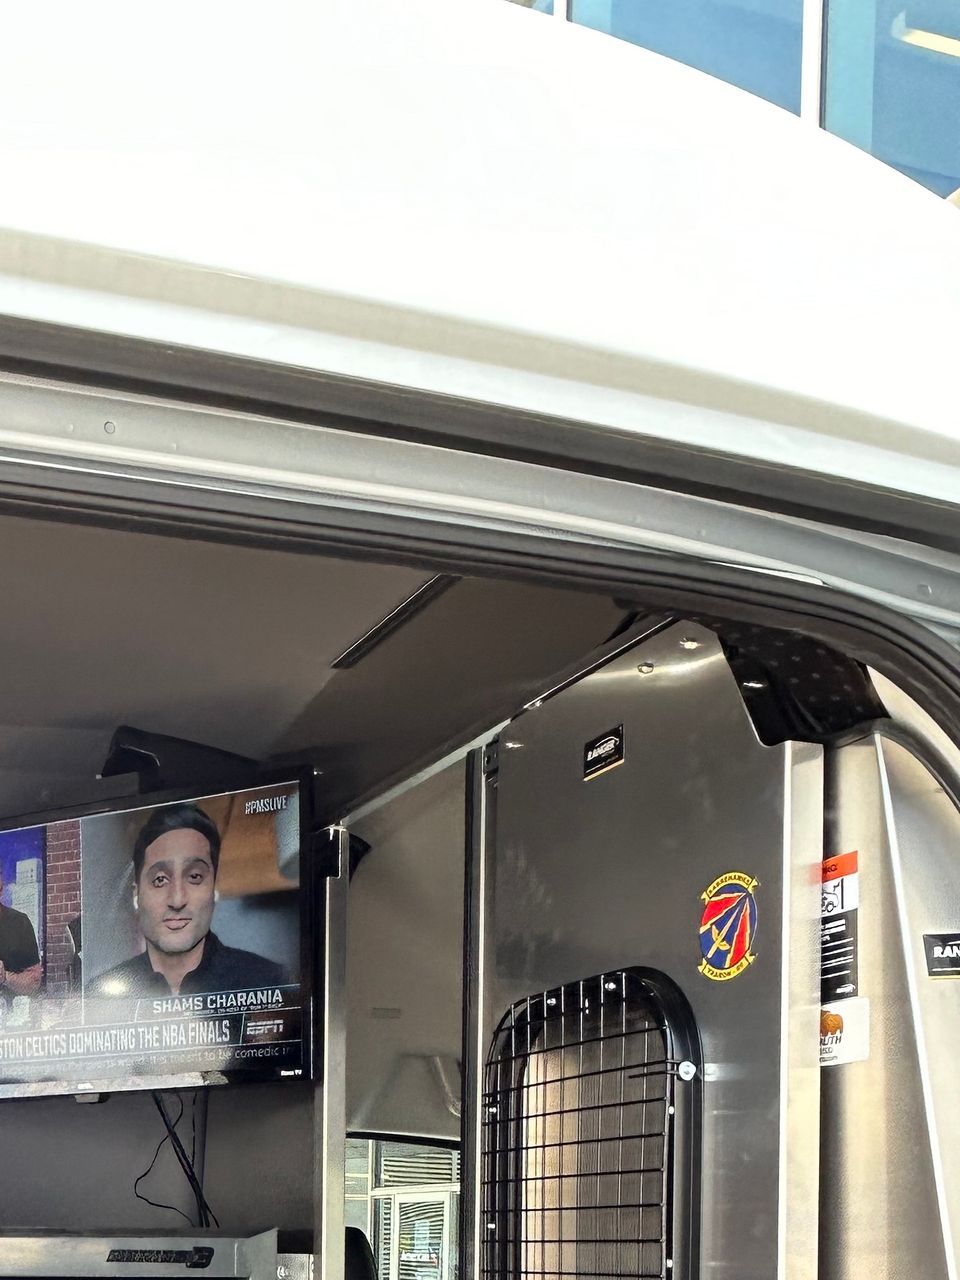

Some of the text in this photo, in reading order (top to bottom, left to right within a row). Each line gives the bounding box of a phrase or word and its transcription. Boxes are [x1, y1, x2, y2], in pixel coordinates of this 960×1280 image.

[153, 996, 203, 1014] SHAMS
[207, 989, 283, 1009] CHARANIA
[25, 1033, 67, 1057] CELTICS
[69, 1028, 135, 1053] DOMINATING
[139, 1024, 159, 1049] THE
[162, 1023, 186, 1047] NBA
[188, 1019, 230, 1045] FINALS
[234, 1046, 280, 1059] comedic
